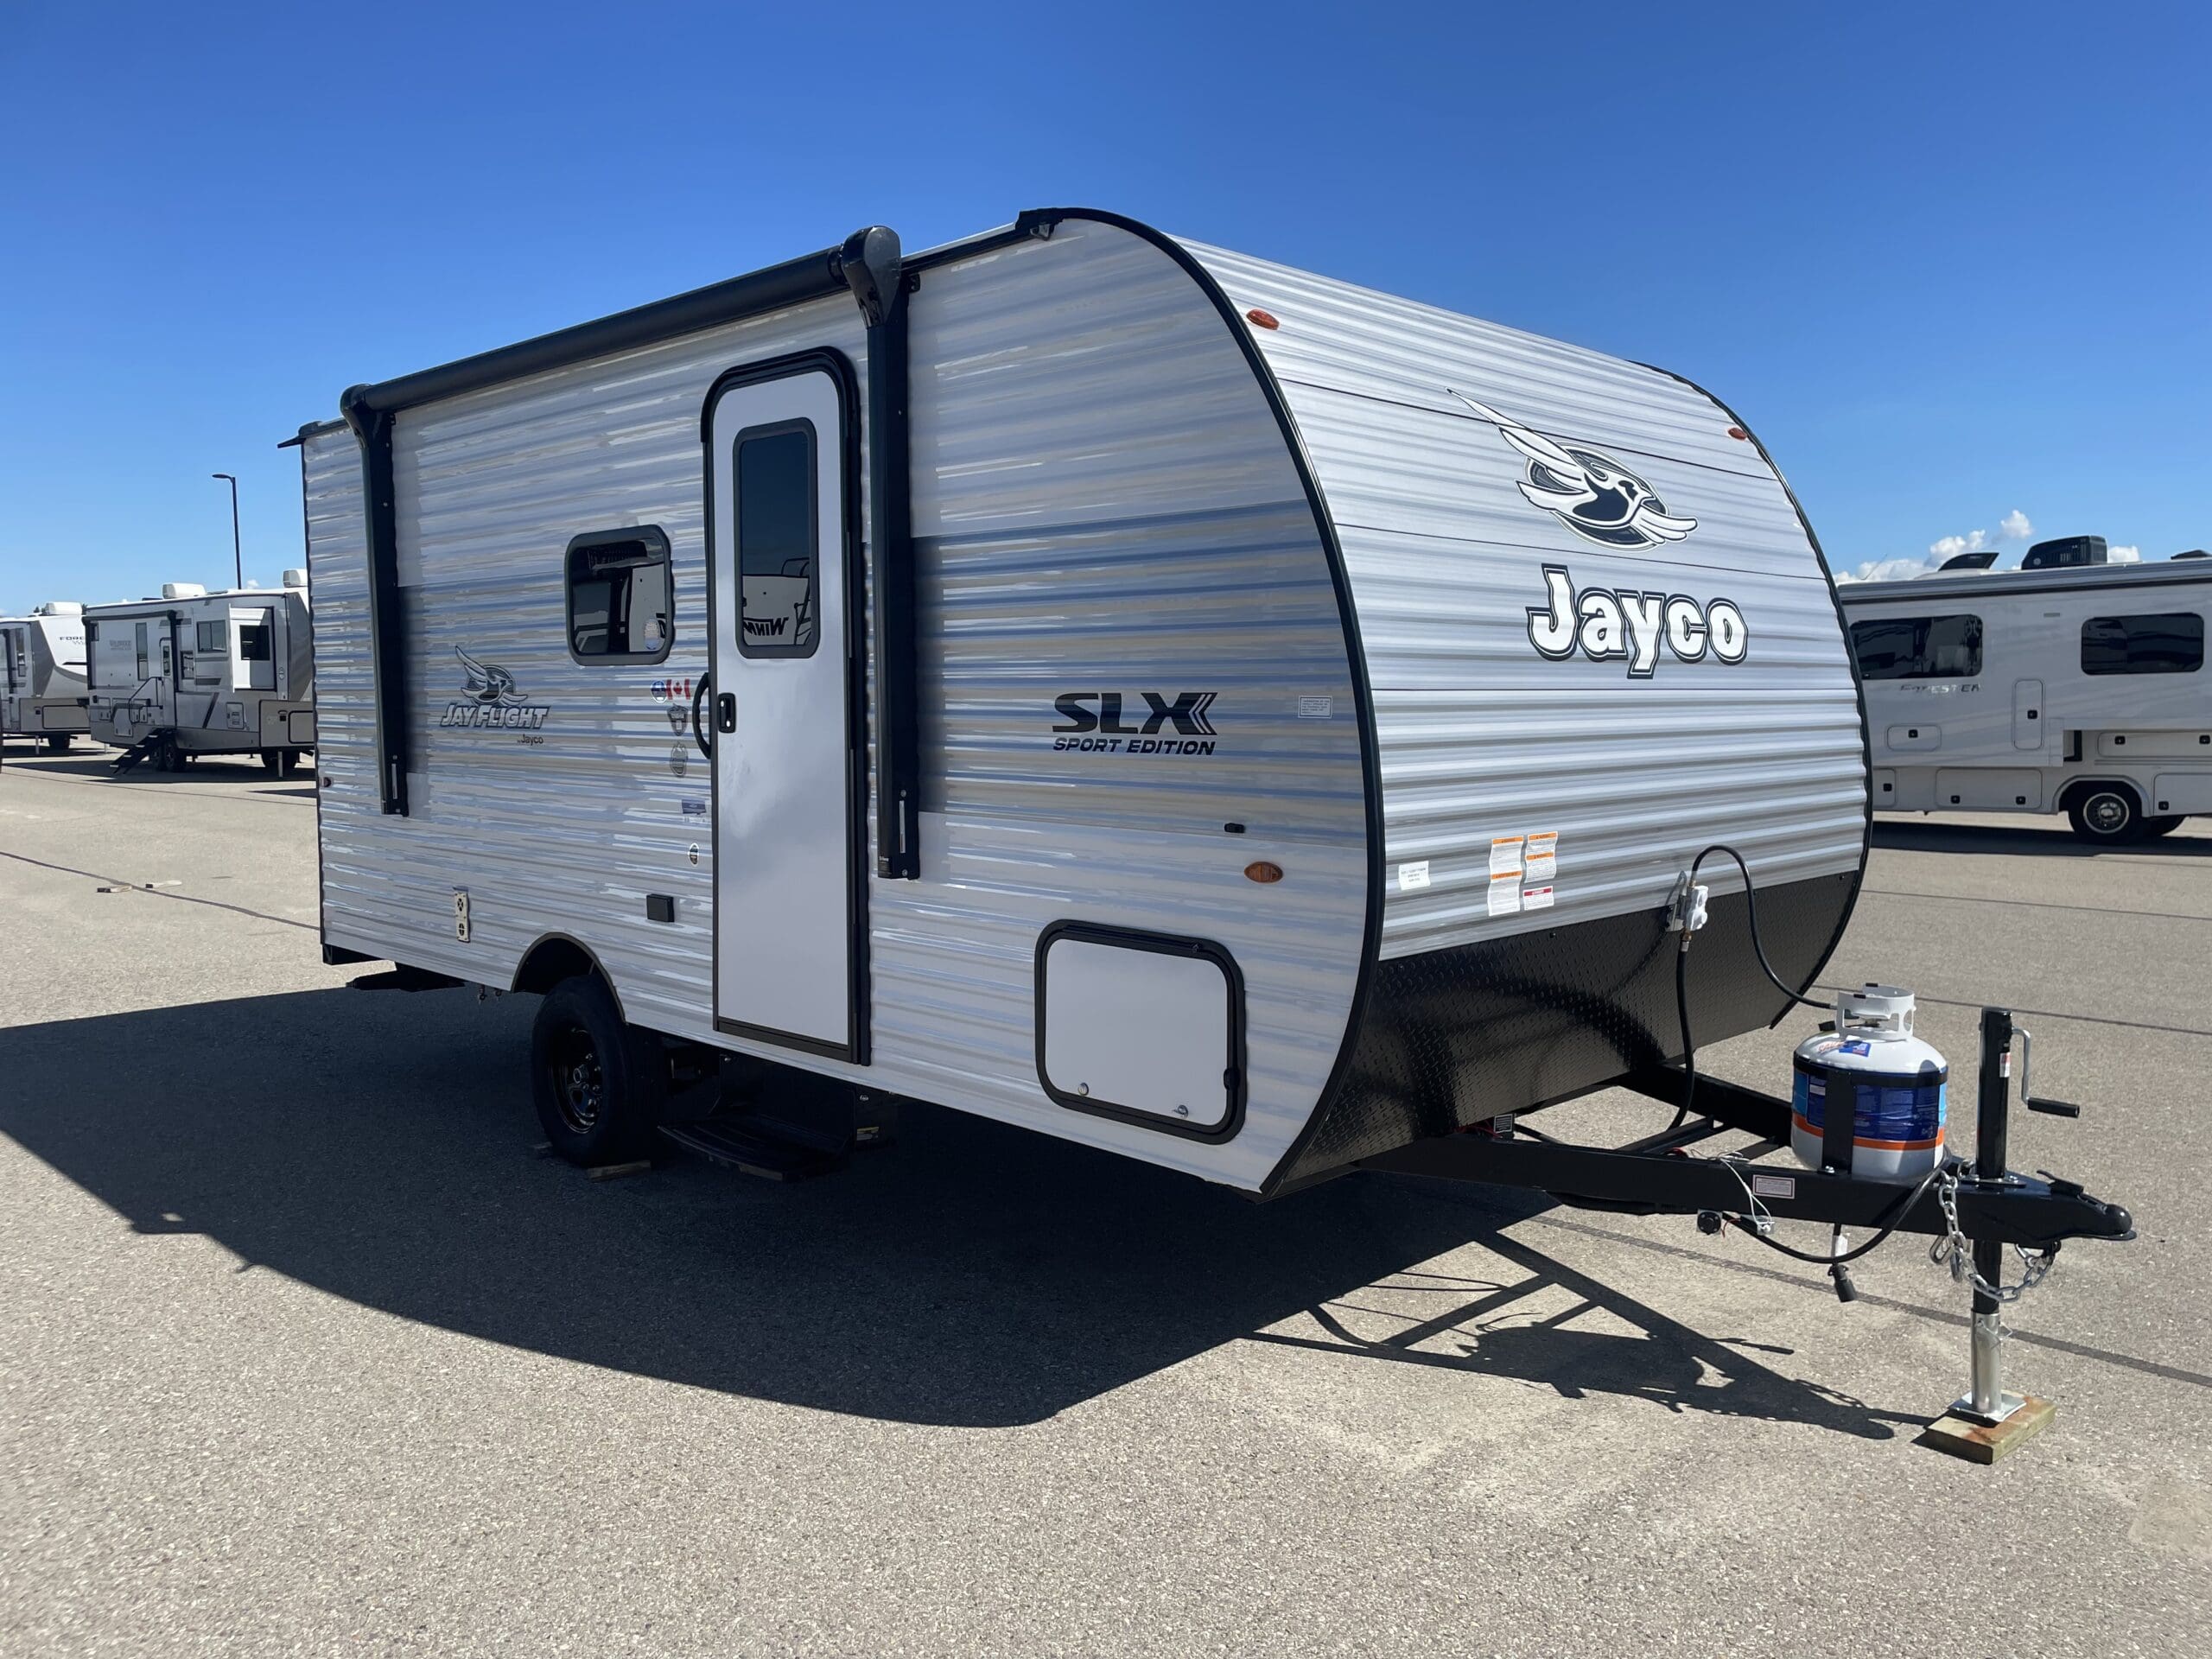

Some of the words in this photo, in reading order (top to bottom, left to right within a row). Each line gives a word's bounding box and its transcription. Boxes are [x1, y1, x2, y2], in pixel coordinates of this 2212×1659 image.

[1525, 563, 1748, 679] Jayco
[440, 703, 478, 728] JAY
[474, 704, 551, 729] FLIGHT
[1052, 692, 1217, 735] SLX
[520, 734, 544, 745] Jayco
[1053, 737, 1122, 753] SPORT
[1127, 740, 1216, 755] EDITION
